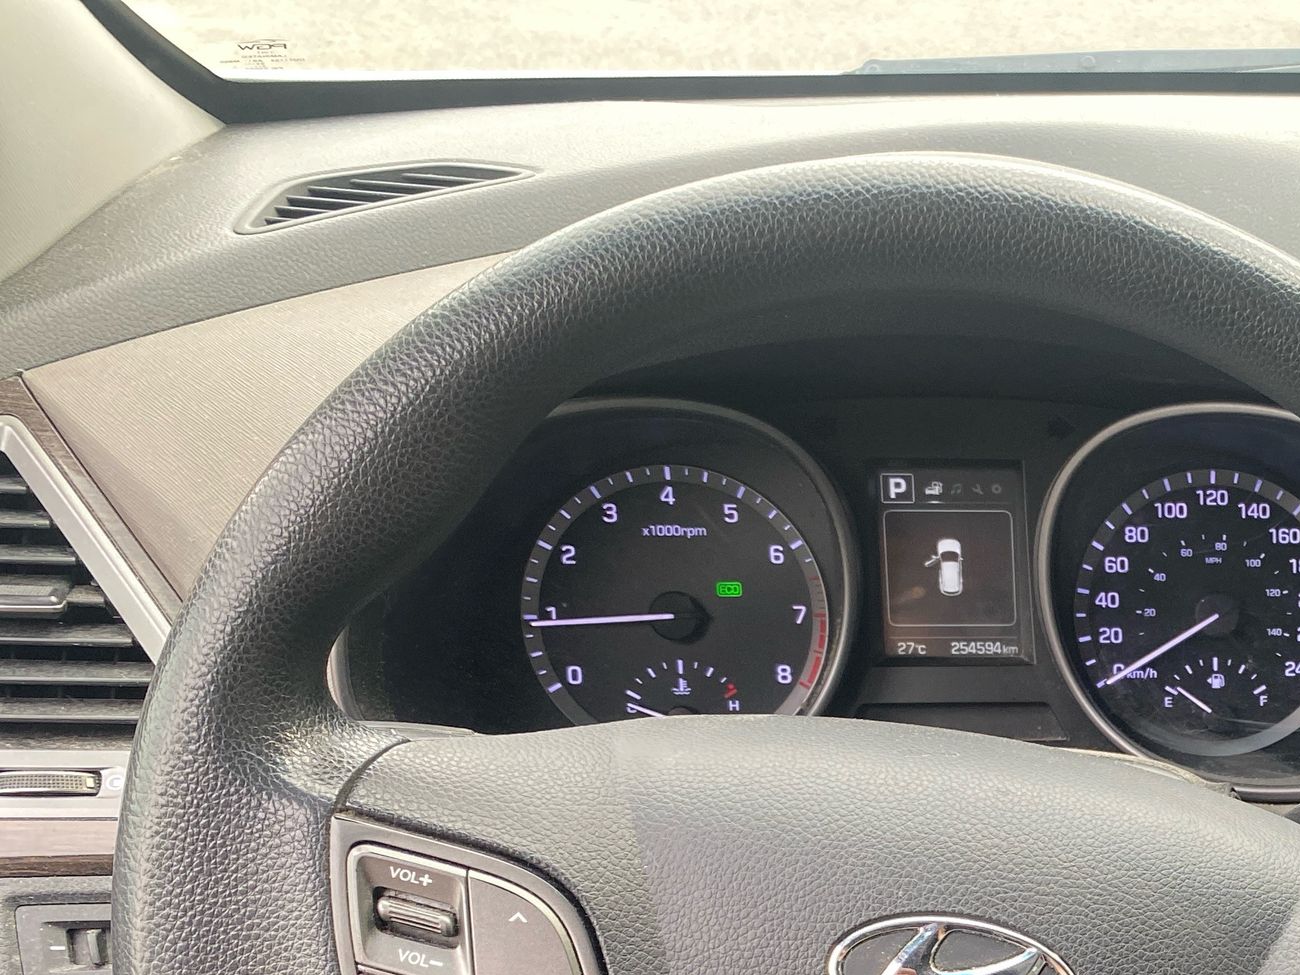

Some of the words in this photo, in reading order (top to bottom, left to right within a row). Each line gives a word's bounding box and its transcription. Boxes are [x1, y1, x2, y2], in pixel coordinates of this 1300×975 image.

[660, 486, 675, 504] 4
[889, 478, 907, 499] P
[1196, 490, 1228, 506] 120
[602, 504, 618, 523] 3
[723, 504, 738, 523] 5
[1154, 503, 1187, 519] 100
[1238, 503, 1270, 519] 140
[642, 525, 707, 538] x1000rpm
[1124, 527, 1149, 543] 80
[1269, 529, 1300, 544] 160
[1180, 549, 1193, 557] 60
[1215, 542, 1228, 551] 80
[561, 545, 577, 565] 2
[769, 545, 784, 565] 6
[1245, 559, 1261, 567] 100
[1104, 557, 1128, 573] 60
[1153, 573, 1166, 582] 40
[1095, 592, 1119, 608] 40
[1265, 588, 1281, 597] 120
[546, 606, 557, 620] 1
[792, 605, 806, 624] 7
[1143, 608, 1156, 617] 20
[1099, 627, 1123, 644] 20
[1266, 628, 1283, 636] 140
[567, 666, 582, 685] 0
[777, 665, 792, 684] 8
[729, 700, 740, 711] H
[1165, 697, 1173, 707] E
[1259, 695, 1268, 707] F
